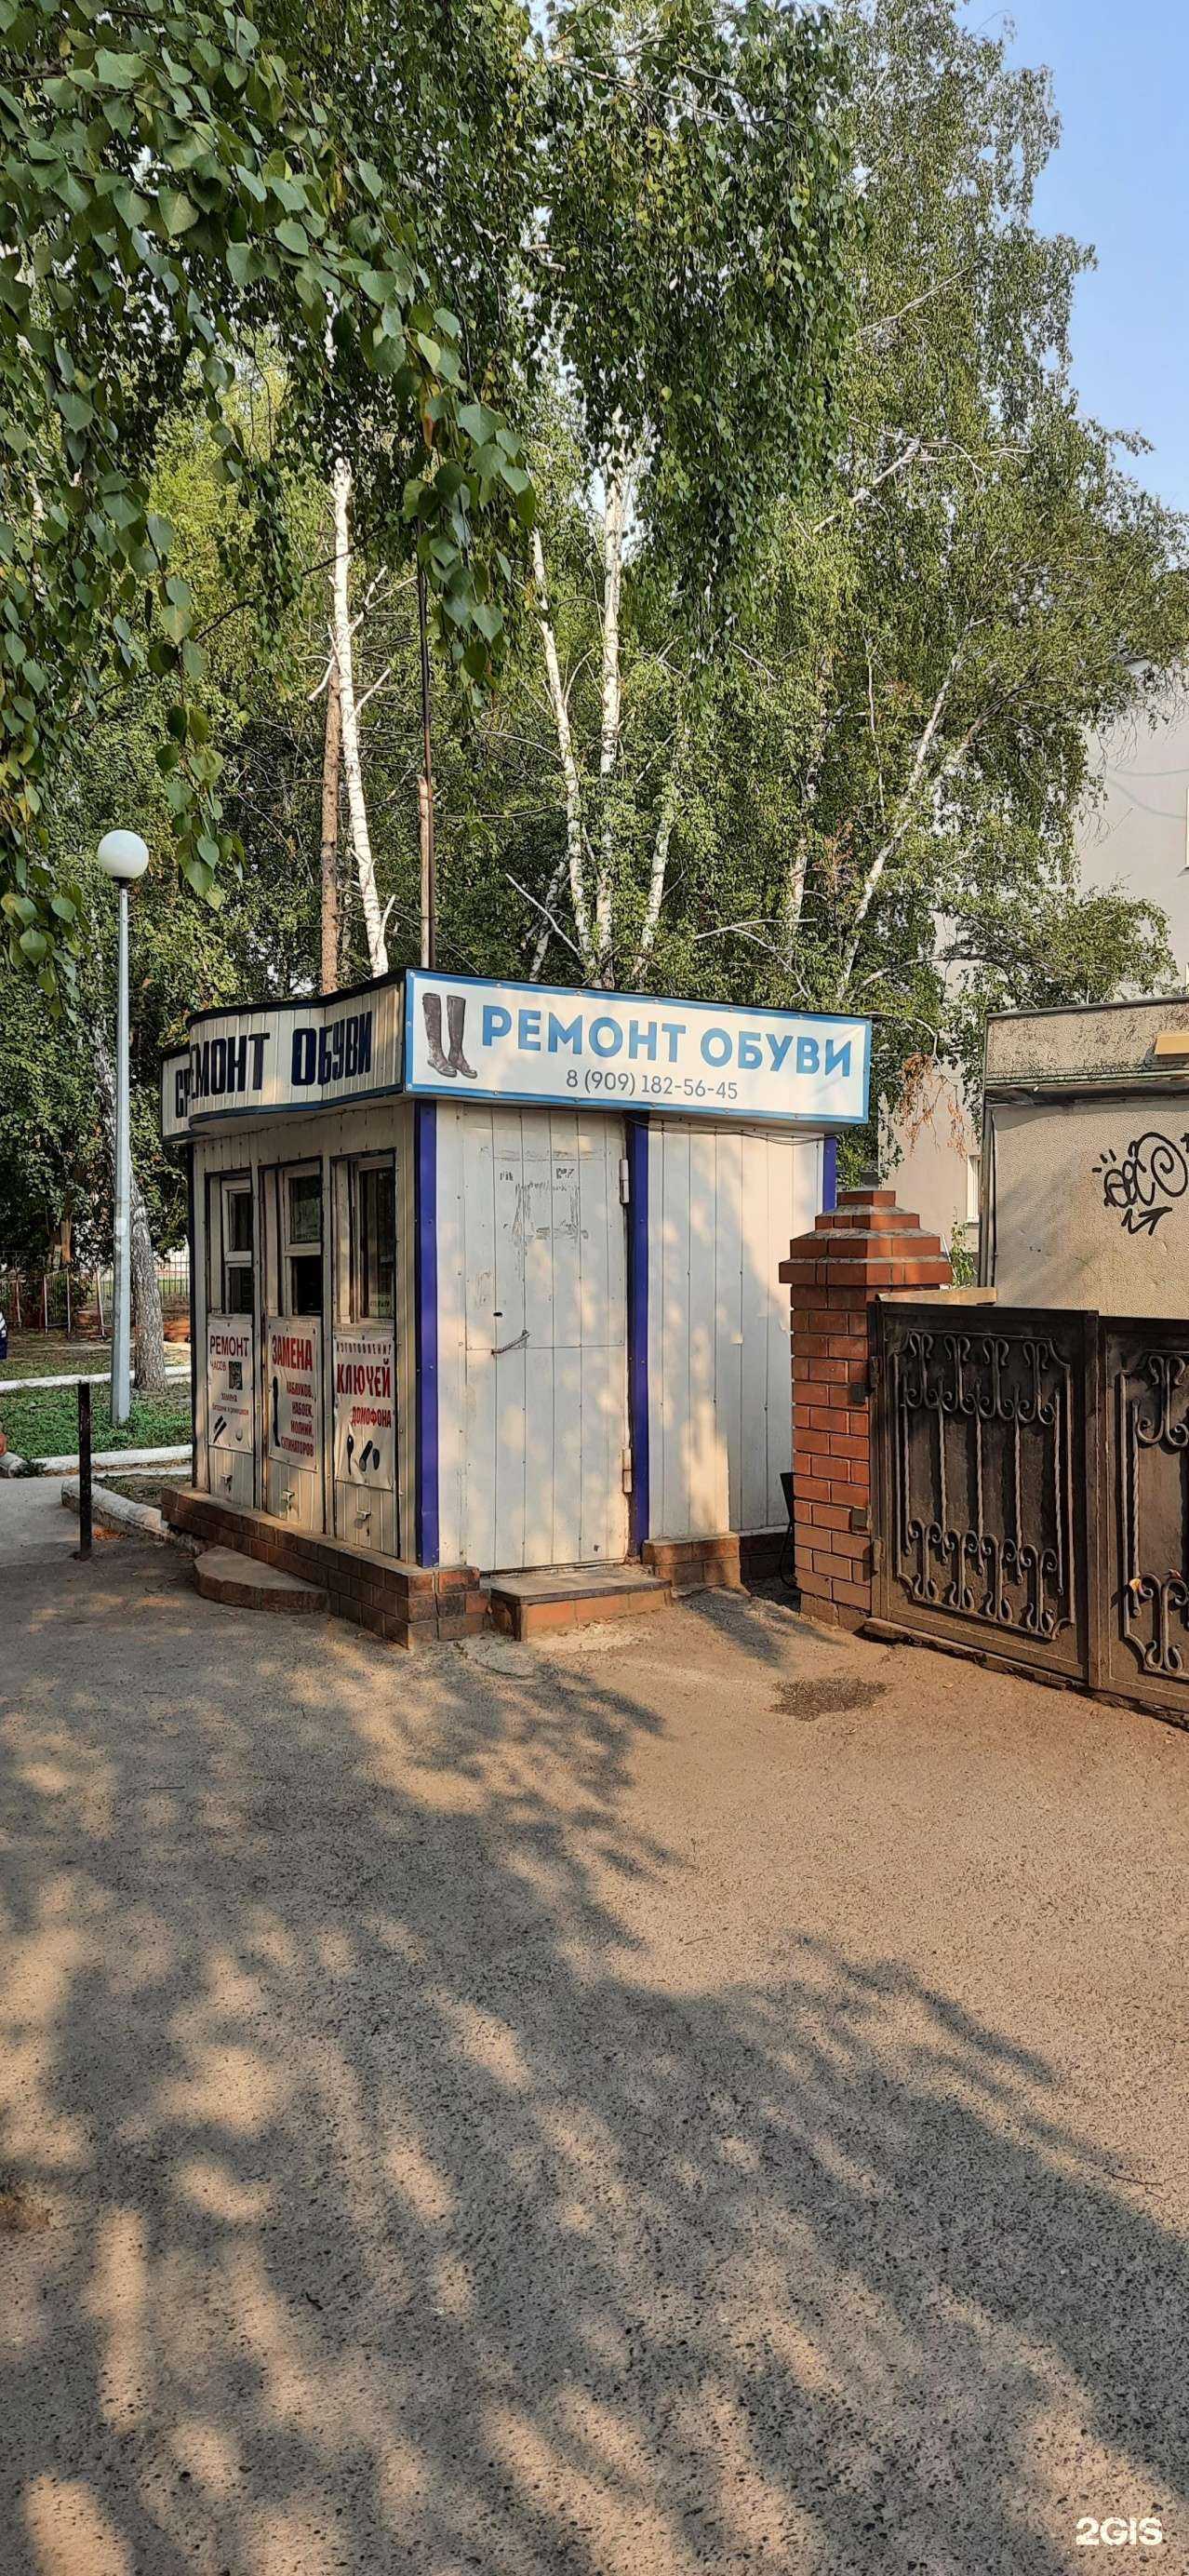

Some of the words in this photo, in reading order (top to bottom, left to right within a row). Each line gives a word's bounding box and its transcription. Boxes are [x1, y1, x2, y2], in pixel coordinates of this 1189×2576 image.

[291, 1011, 372, 1087] ОБУВИ
[482, 1004, 687, 1063] РЕМОНТ
[700, 1026, 851, 1078] ОБУВИ
[566, 1069, 579, 1088] 8
[584, 1070, 635, 1097] (909)
[640, 1073, 739, 1100] 182-56-45
[209, 1335, 249, 1357] РЕМОНТ
[272, 1335, 313, 1371] ЗАМЕНА
[336, 1360, 391, 1399] КЛЮЧЕЙ
[350, 1405, 392, 1429] ДОМОФОНА
